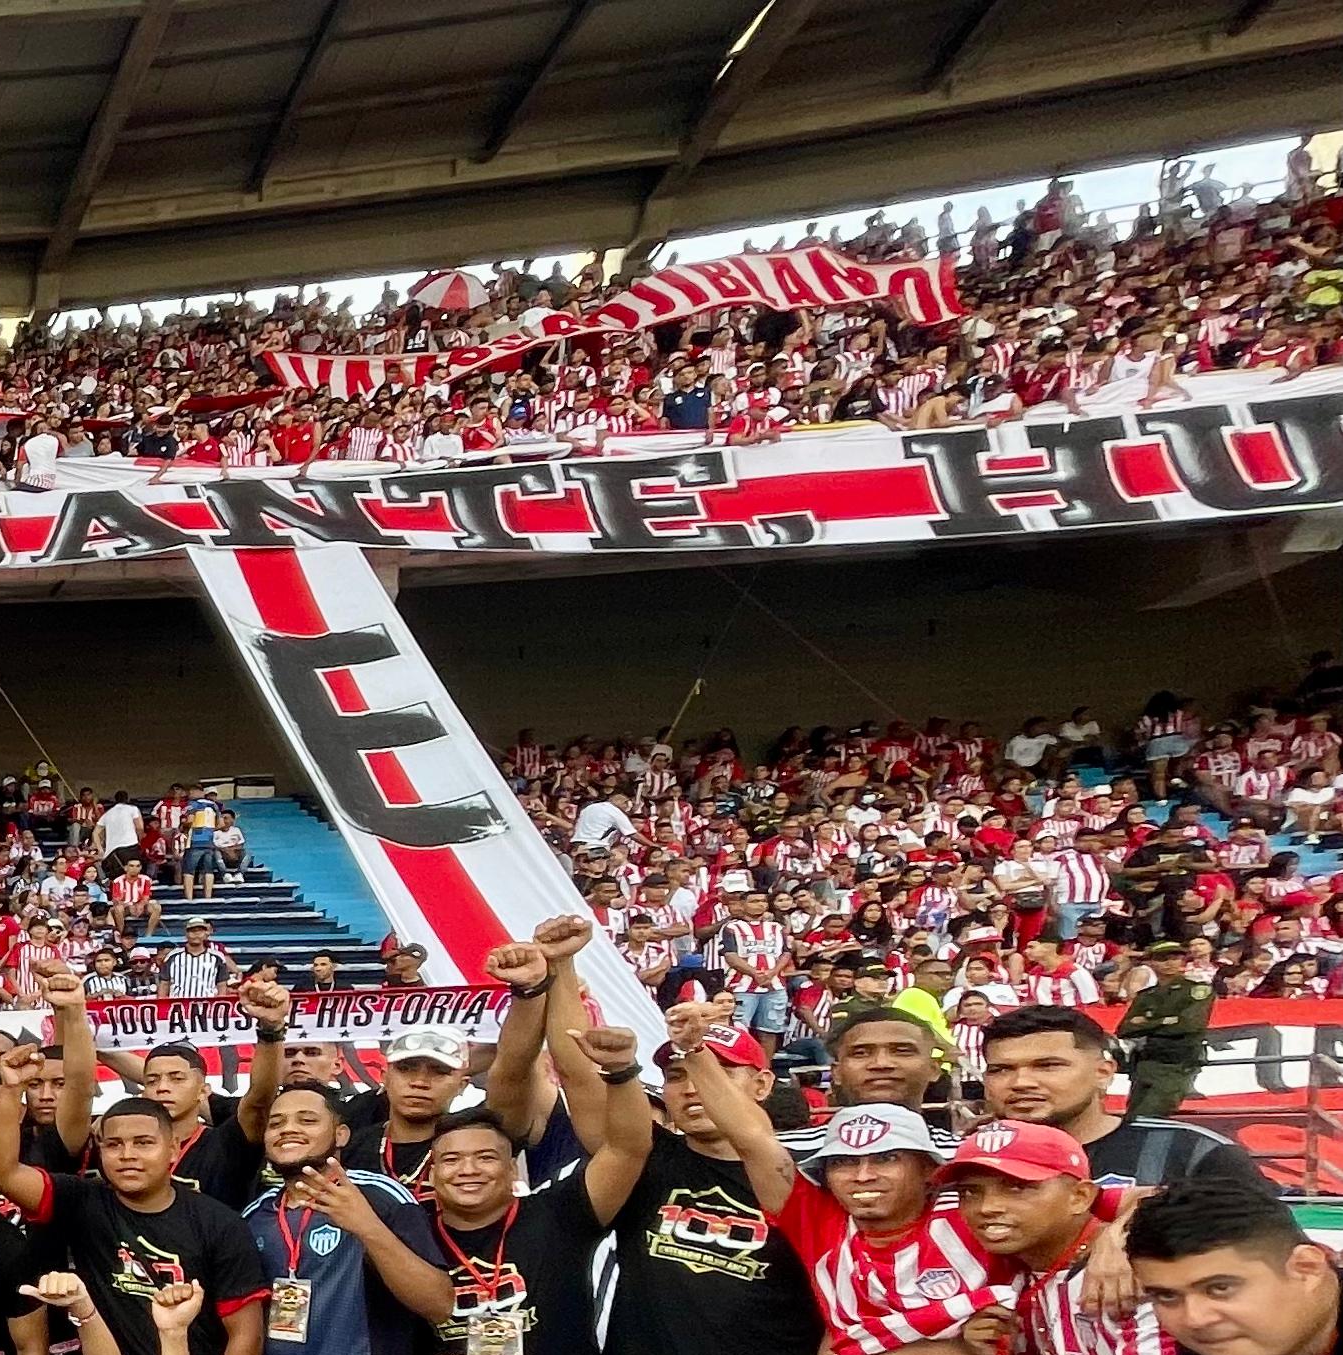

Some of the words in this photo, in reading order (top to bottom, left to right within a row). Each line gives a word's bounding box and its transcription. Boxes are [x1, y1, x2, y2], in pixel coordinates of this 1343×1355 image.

[258, 622, 500, 848] E
[105, 1004, 158, 1037] 100
[317, 990, 495, 1029] HISTORIA
[659, 1205, 768, 1250] 100
[452, 1273, 527, 1318] 00
